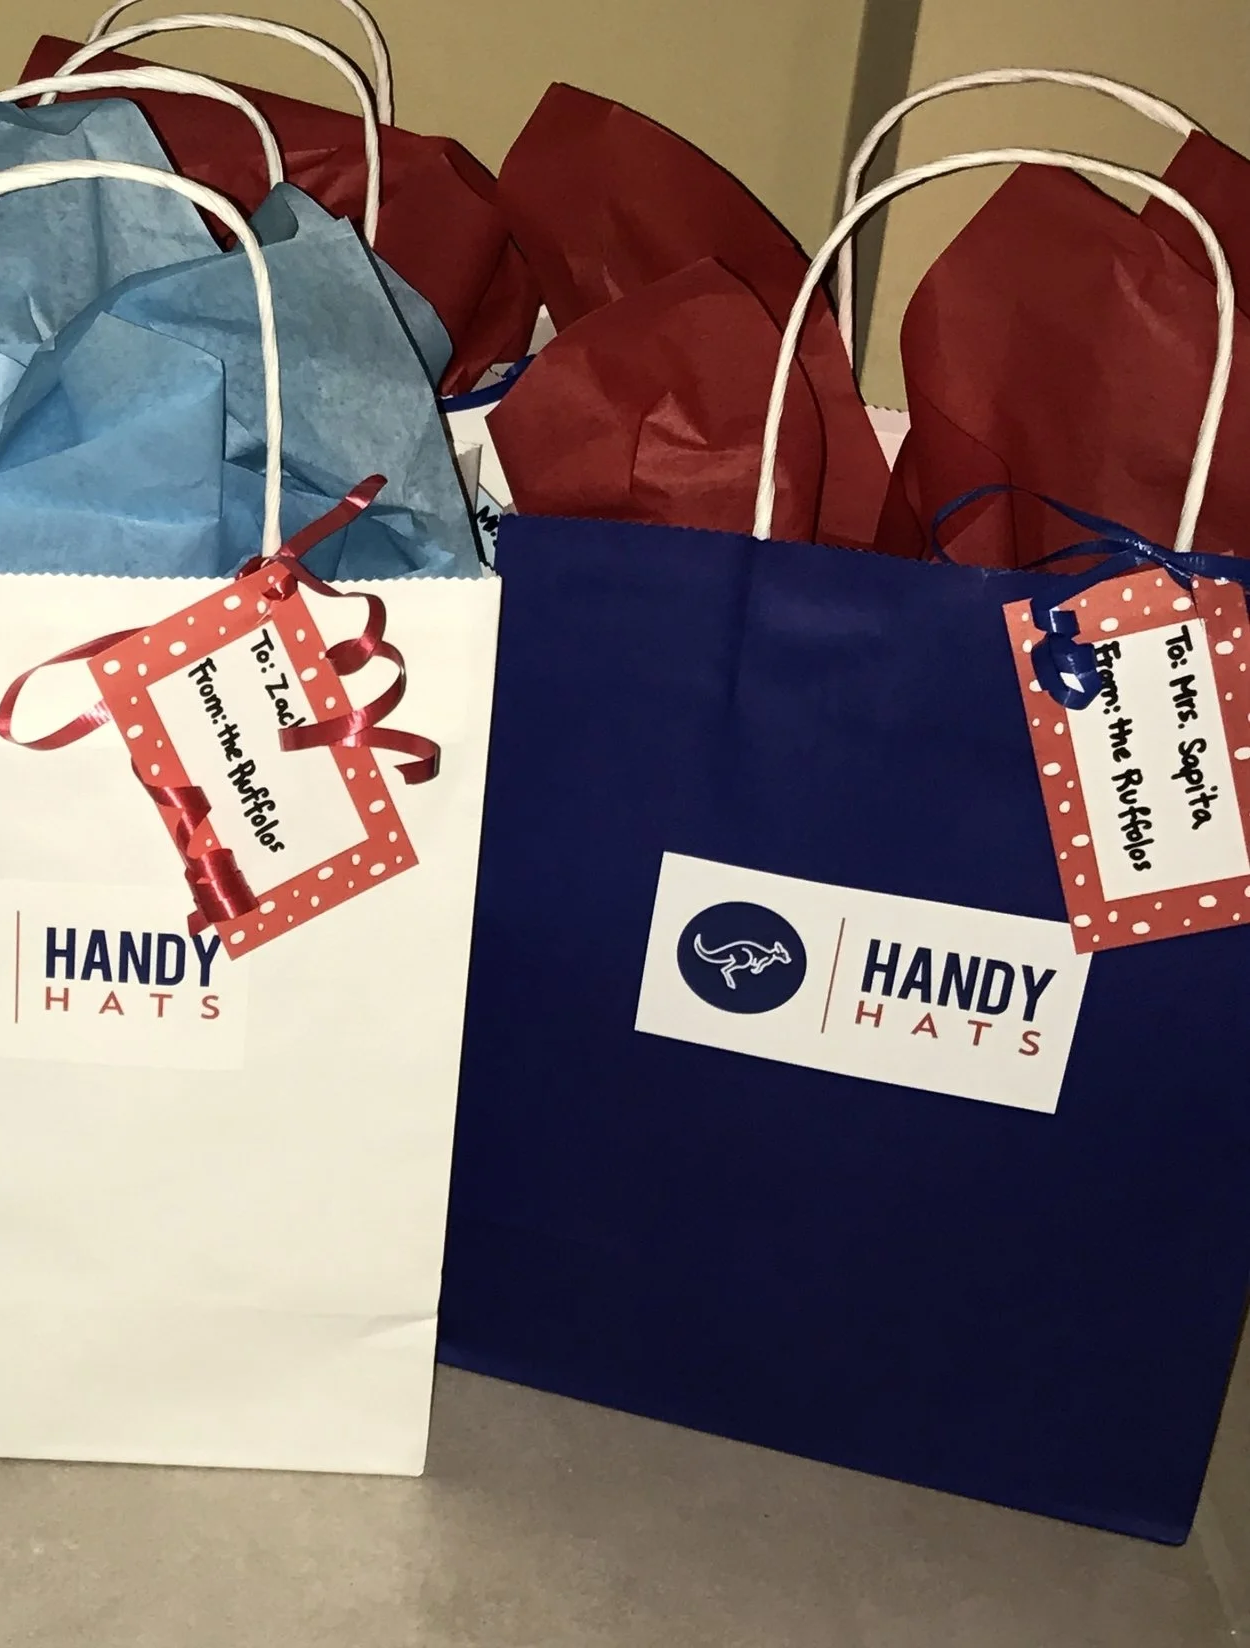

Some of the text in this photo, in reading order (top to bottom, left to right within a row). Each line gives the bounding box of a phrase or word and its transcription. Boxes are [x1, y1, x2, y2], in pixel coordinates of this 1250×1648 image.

[250, 628, 275, 673] To:
[1165, 624, 1193, 669] To:
[1169, 674, 1198, 729] Mrs.
[188, 657, 285, 853] From: the Ruffolos
[1108, 718, 1133, 763] the
[1111, 768, 1154, 872] Ruffolos
[45, 926, 222, 988] HANDY
[860, 938, 1057, 1022] HANDY
[44, 985, 221, 1020] HATS
[854, 1000, 1042, 1057] HATS
